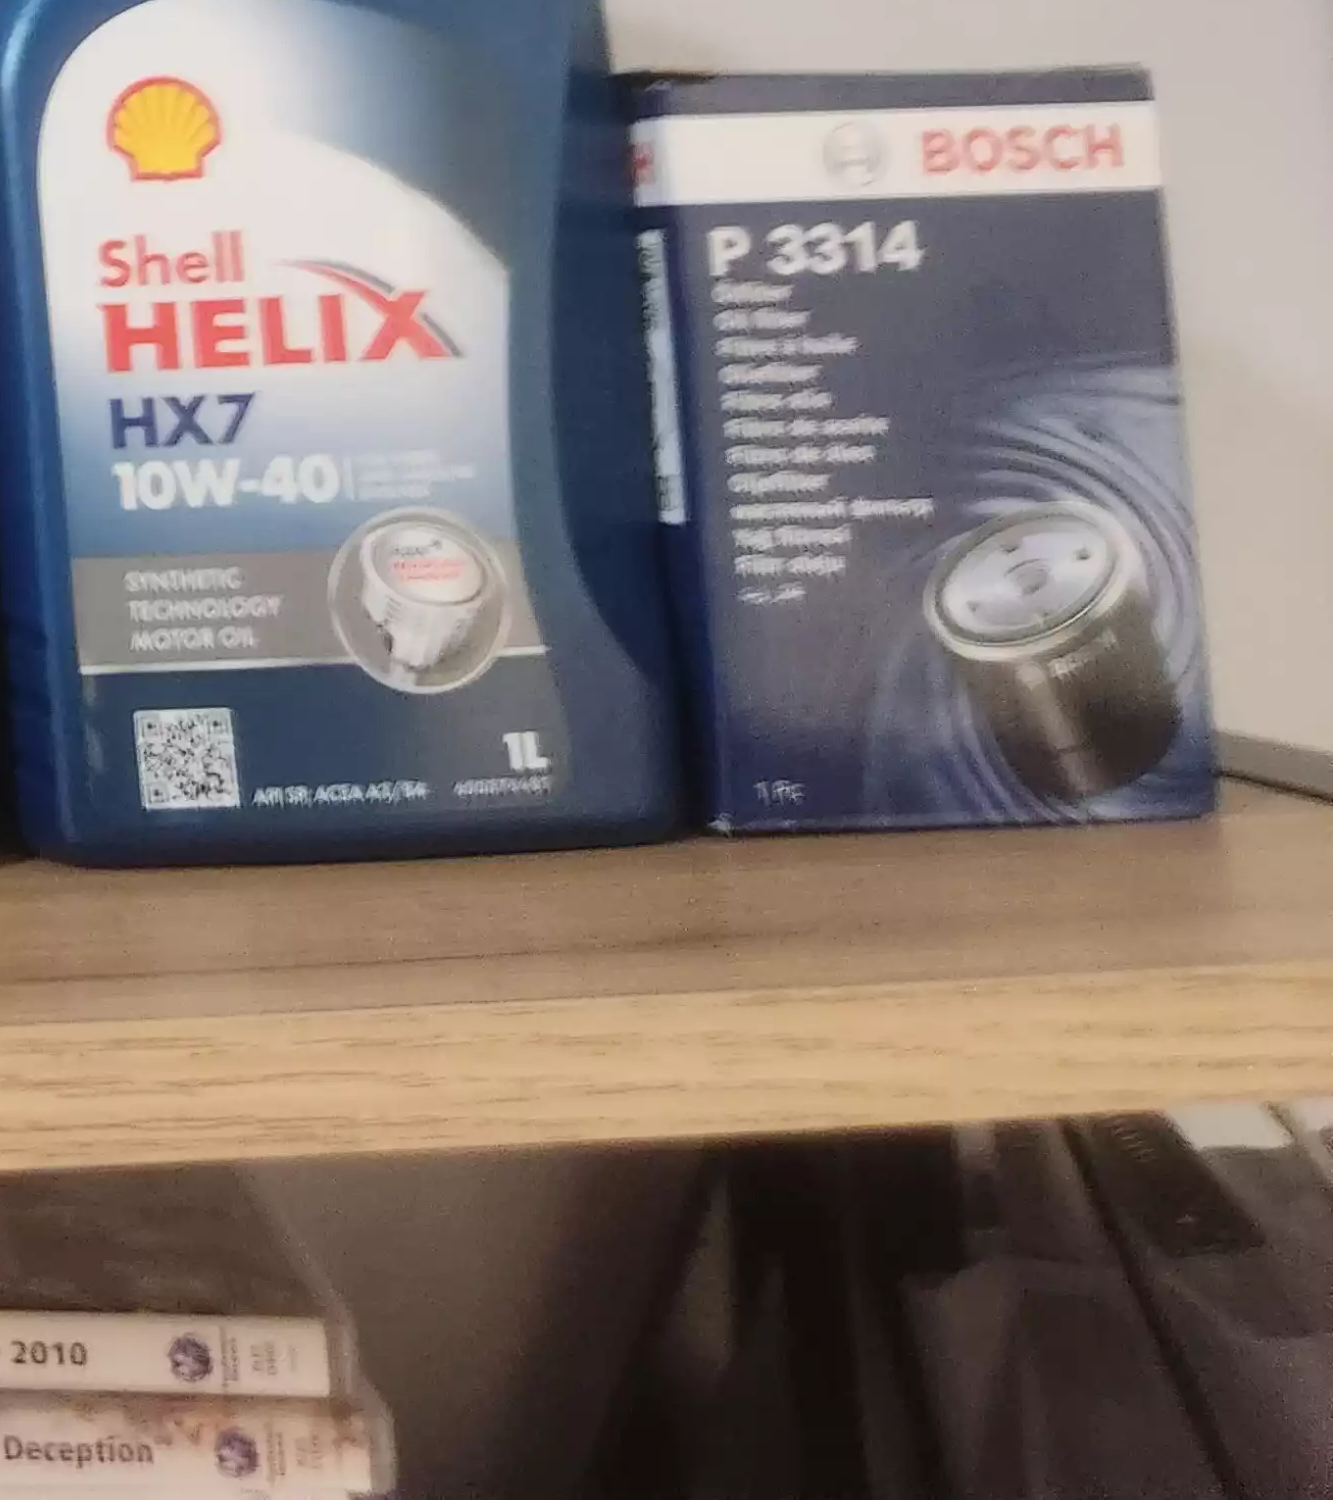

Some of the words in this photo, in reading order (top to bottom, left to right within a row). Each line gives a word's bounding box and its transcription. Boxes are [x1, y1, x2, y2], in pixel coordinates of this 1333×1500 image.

[920, 123, 1125, 176] BOSCH
[97, 230, 245, 288] Shell
[707, 225, 753, 277] P
[766, 219, 926, 277] 3314
[96, 289, 464, 373] HELIX
[108, 390, 257, 450] HX7
[112, 453, 341, 512] 10W-40
[126, 594, 283, 622] TECHNOLOGY
[130, 626, 215, 652] MOTOR
[502, 731, 551, 772] 1L
[9, 1340, 89, 1366] 2010
[3, 1434, 155, 1469] Deception
